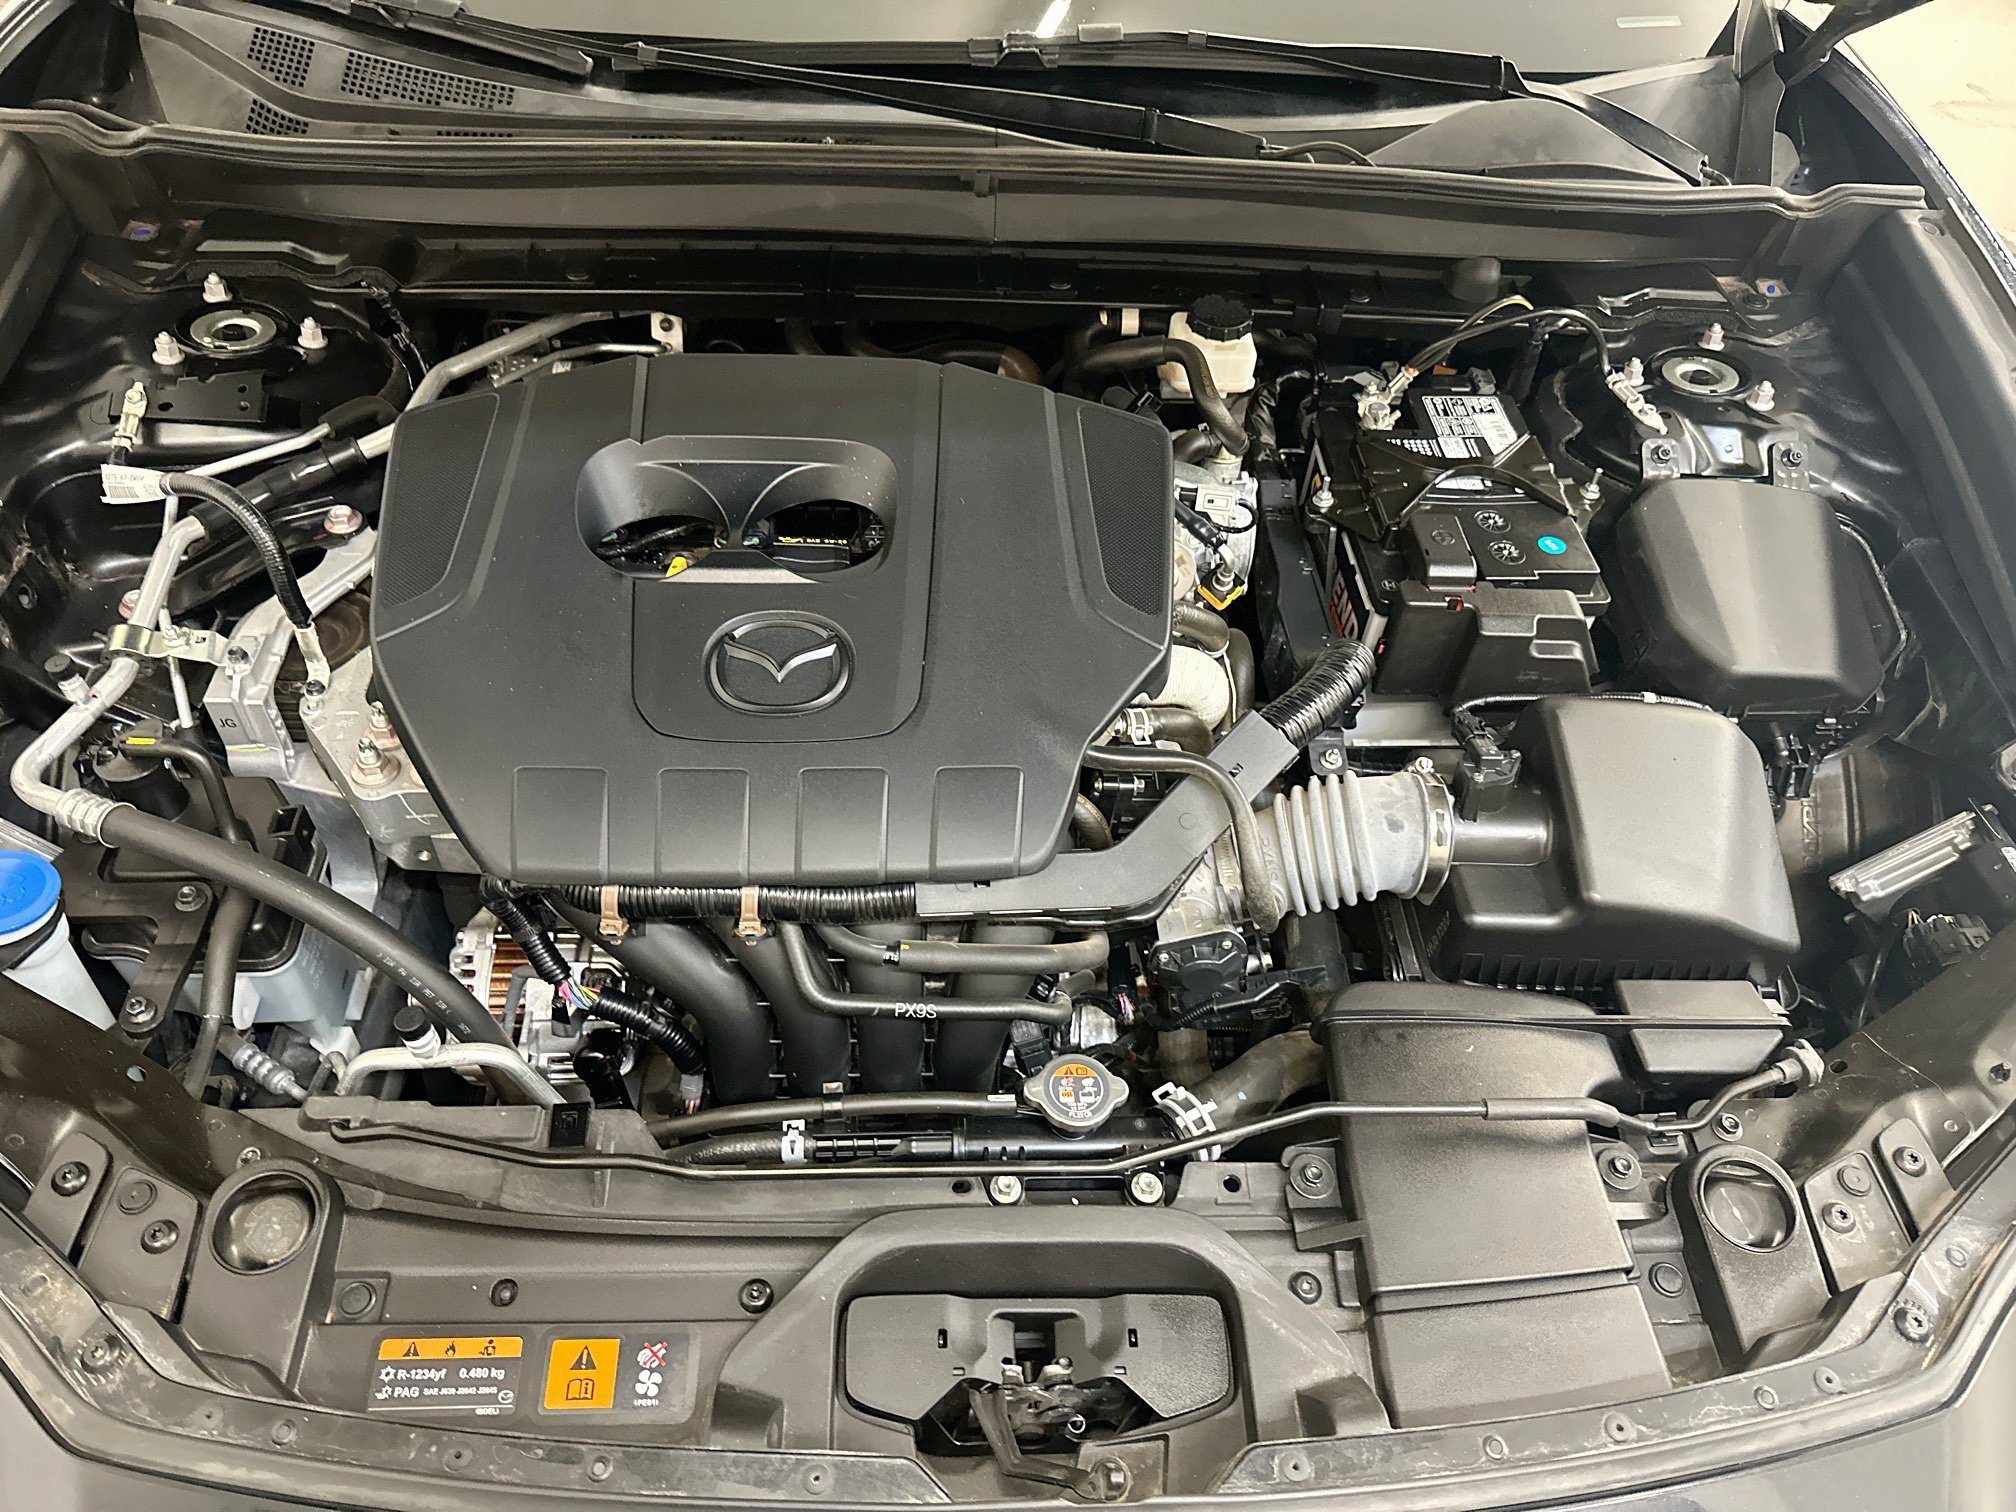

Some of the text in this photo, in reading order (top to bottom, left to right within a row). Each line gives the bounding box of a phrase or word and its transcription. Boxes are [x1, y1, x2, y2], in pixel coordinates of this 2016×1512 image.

[219, 718, 237, 728] JG
[894, 1002, 937, 1019] PX9S
[396, 1367, 505, 1382] R-1234yf 0.480 kg
[393, 1386, 419, 1398] PAG
[423, 1387, 439, 1396] SAE
